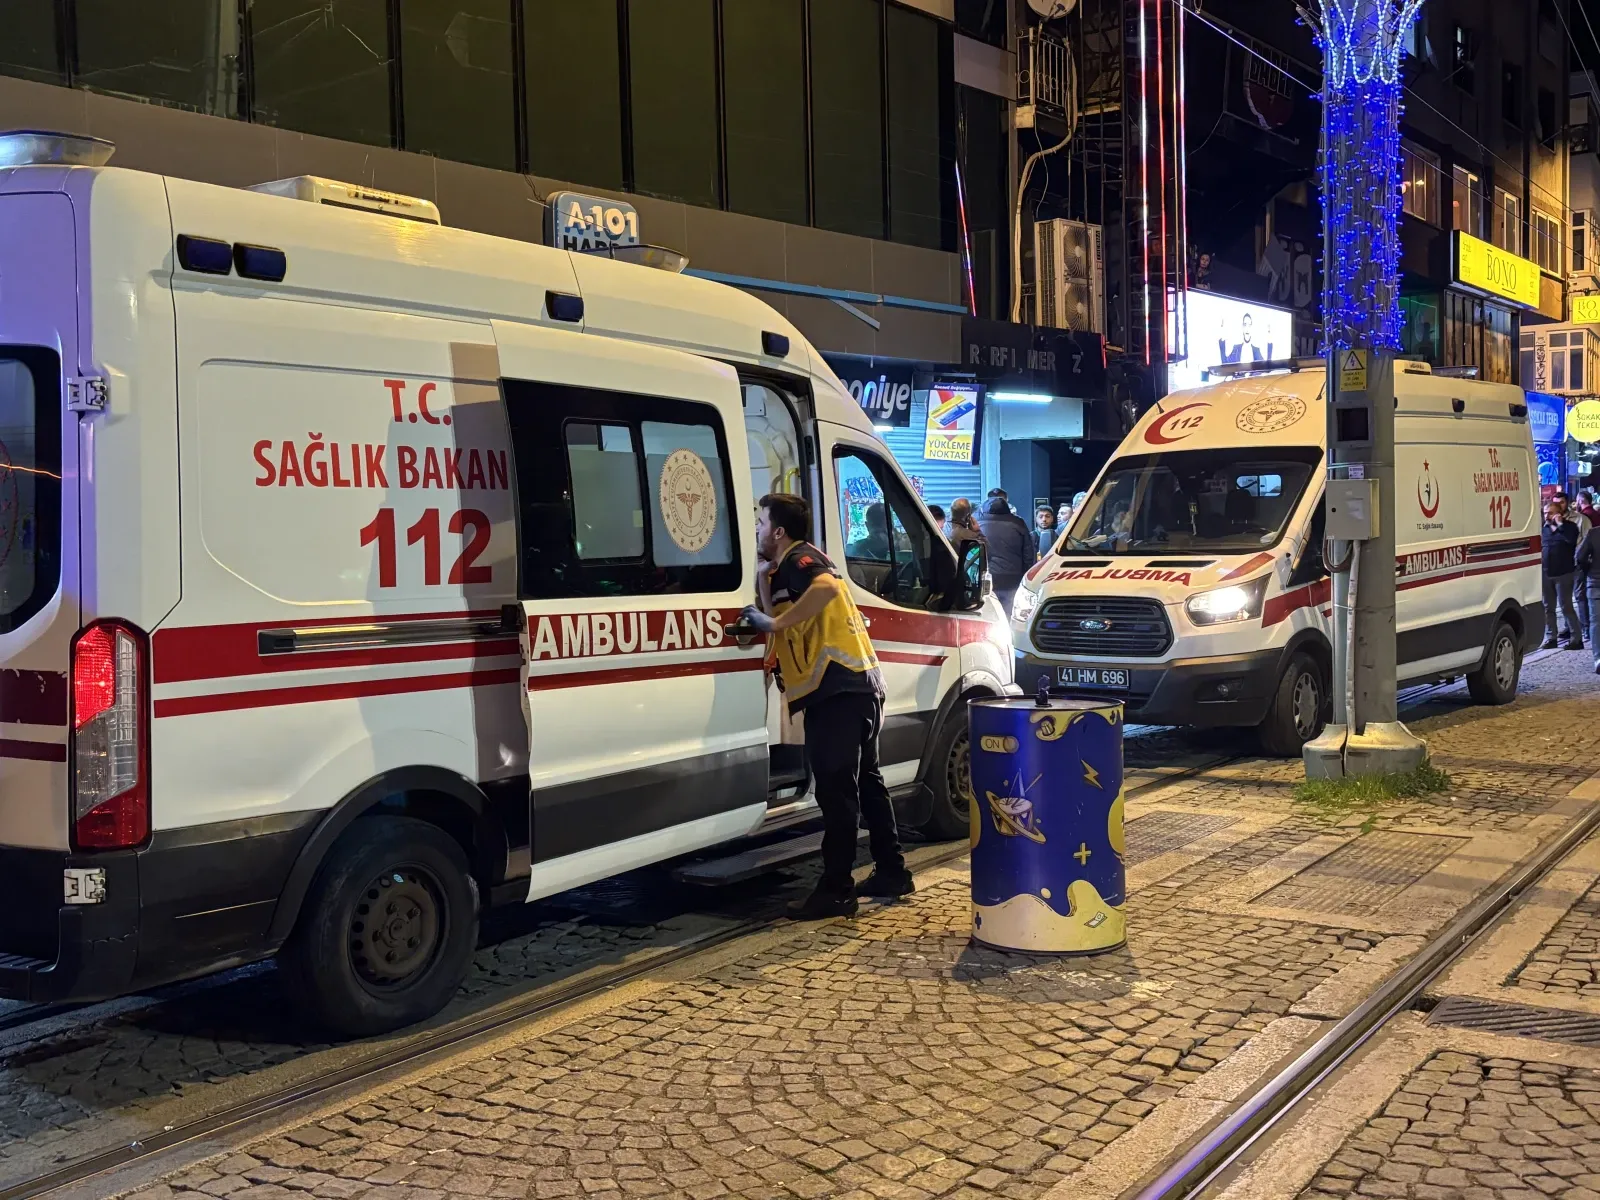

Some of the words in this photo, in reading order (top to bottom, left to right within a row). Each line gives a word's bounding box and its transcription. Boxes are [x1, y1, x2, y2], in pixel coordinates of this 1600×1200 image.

[1486, 253, 1517, 290] BONO
[383, 379, 451, 426] T.C.
[1169, 415, 1204, 431] 112
[1577, 421, 1600, 429] TEKEL
[928, 438, 971, 451] YÜKLEME
[929, 450, 969, 460] NOKTASI
[252, 431, 387, 489] SAĞLIK
[398, 445, 509, 490] BAKAN
[1489, 495, 1512, 529] 112
[359, 507, 493, 588] 112
[1405, 546, 1463, 575] AMBULANS
[531, 609, 724, 661] AMBULANS
[1061, 668, 1073, 682] 41
[1077, 669, 1097, 684] HM
[1101, 670, 1125, 685] 696
[985, 738, 1000, 749] ON
